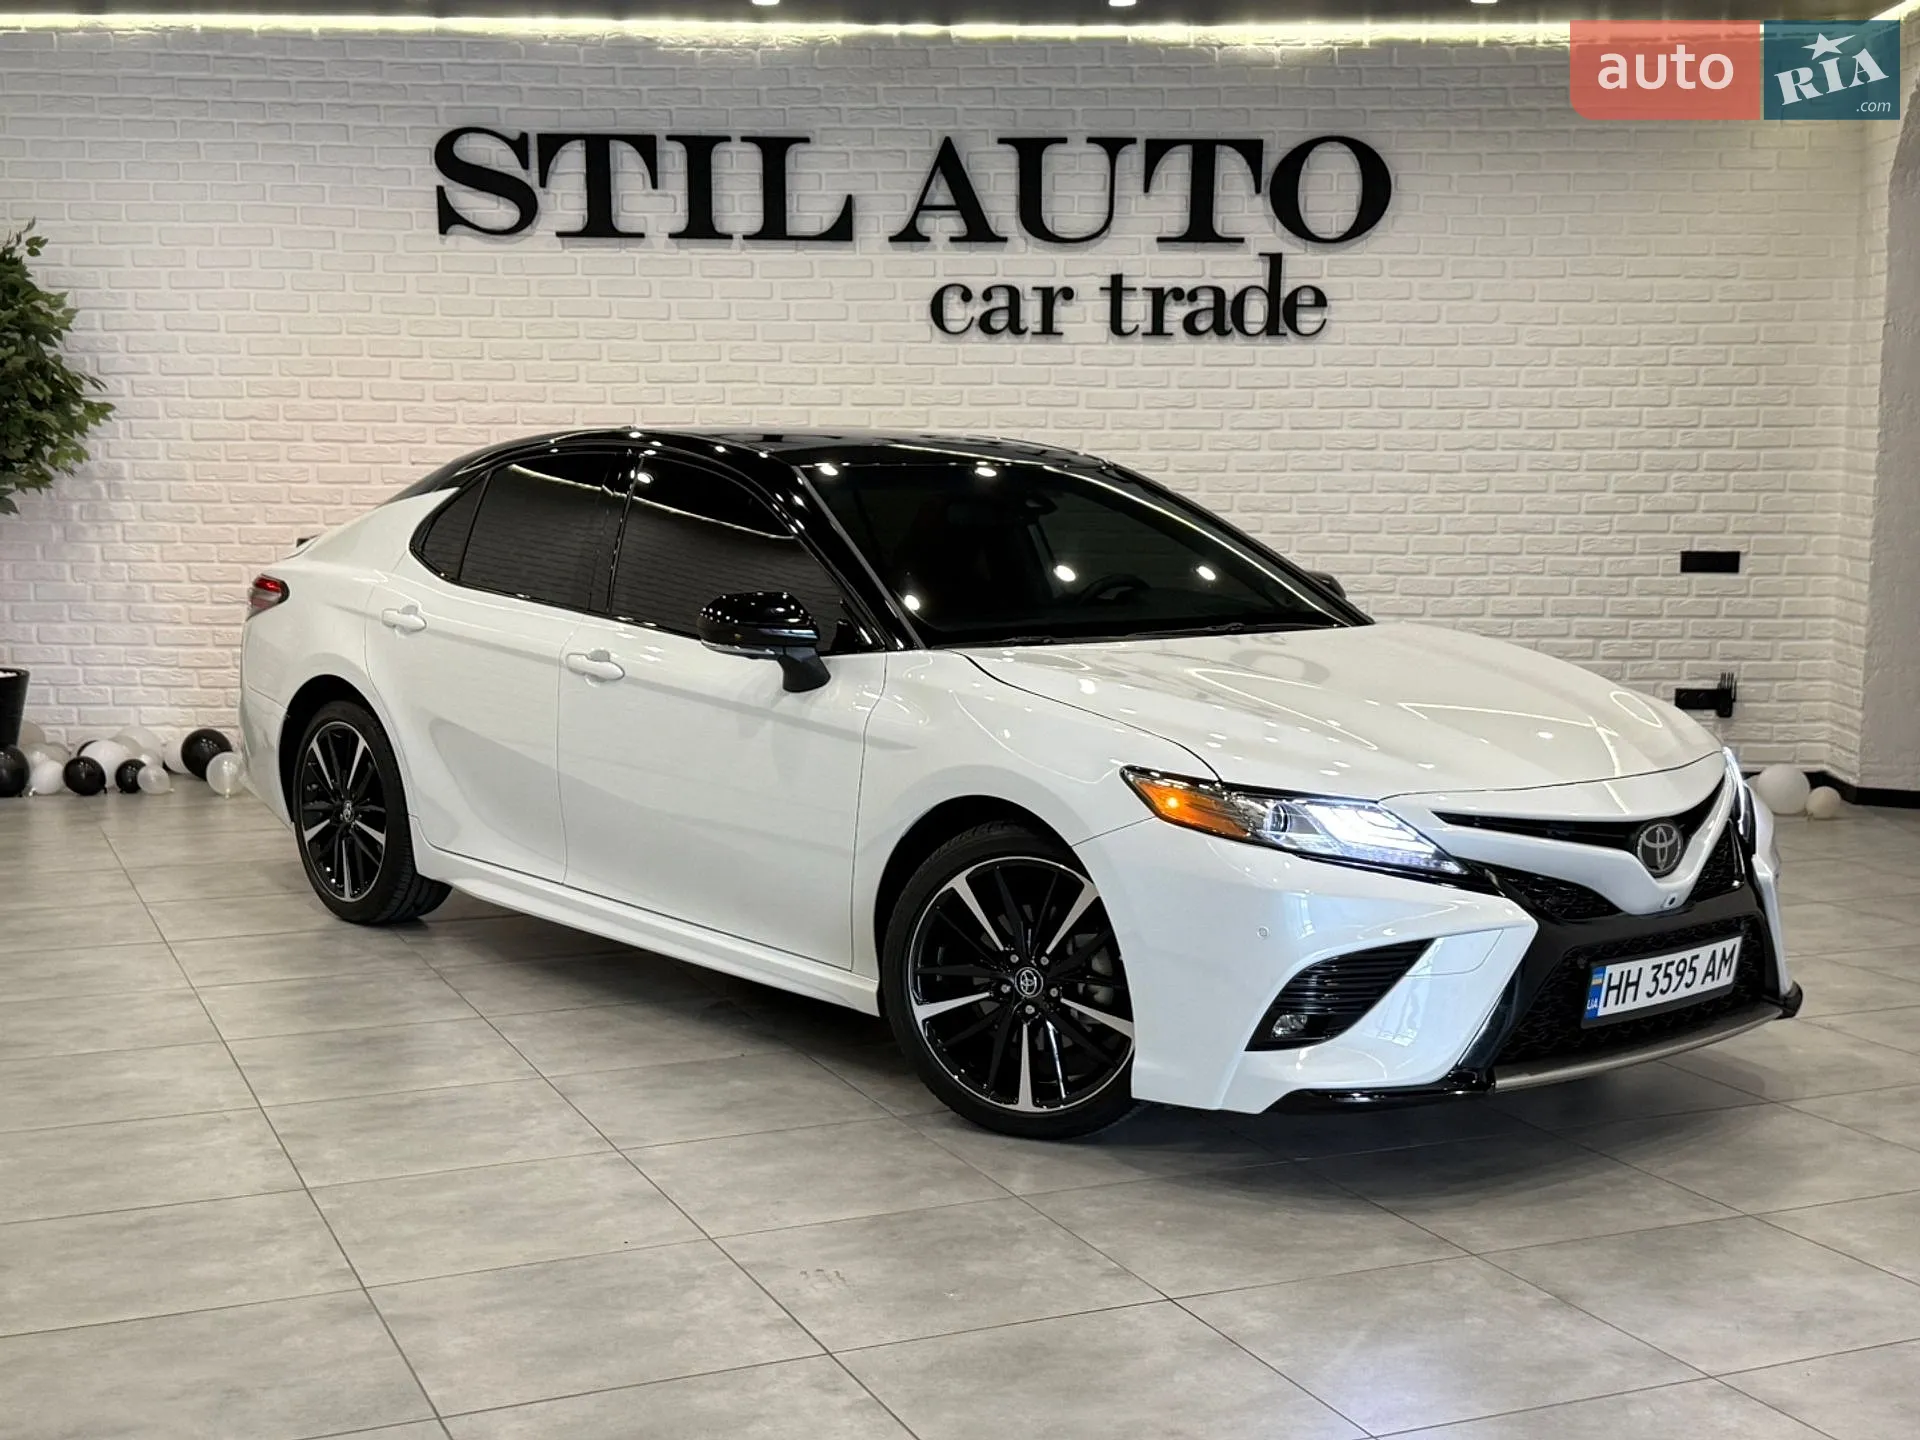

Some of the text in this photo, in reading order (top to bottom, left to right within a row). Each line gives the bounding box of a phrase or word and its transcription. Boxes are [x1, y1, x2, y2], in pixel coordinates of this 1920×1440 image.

[433, 127, 1392, 243] STIL AUTO
[930, 253, 1328, 337] car trade
[1586, 998, 1598, 1010] UA
[1603, 944, 1738, 1008] HH 3595 AM
